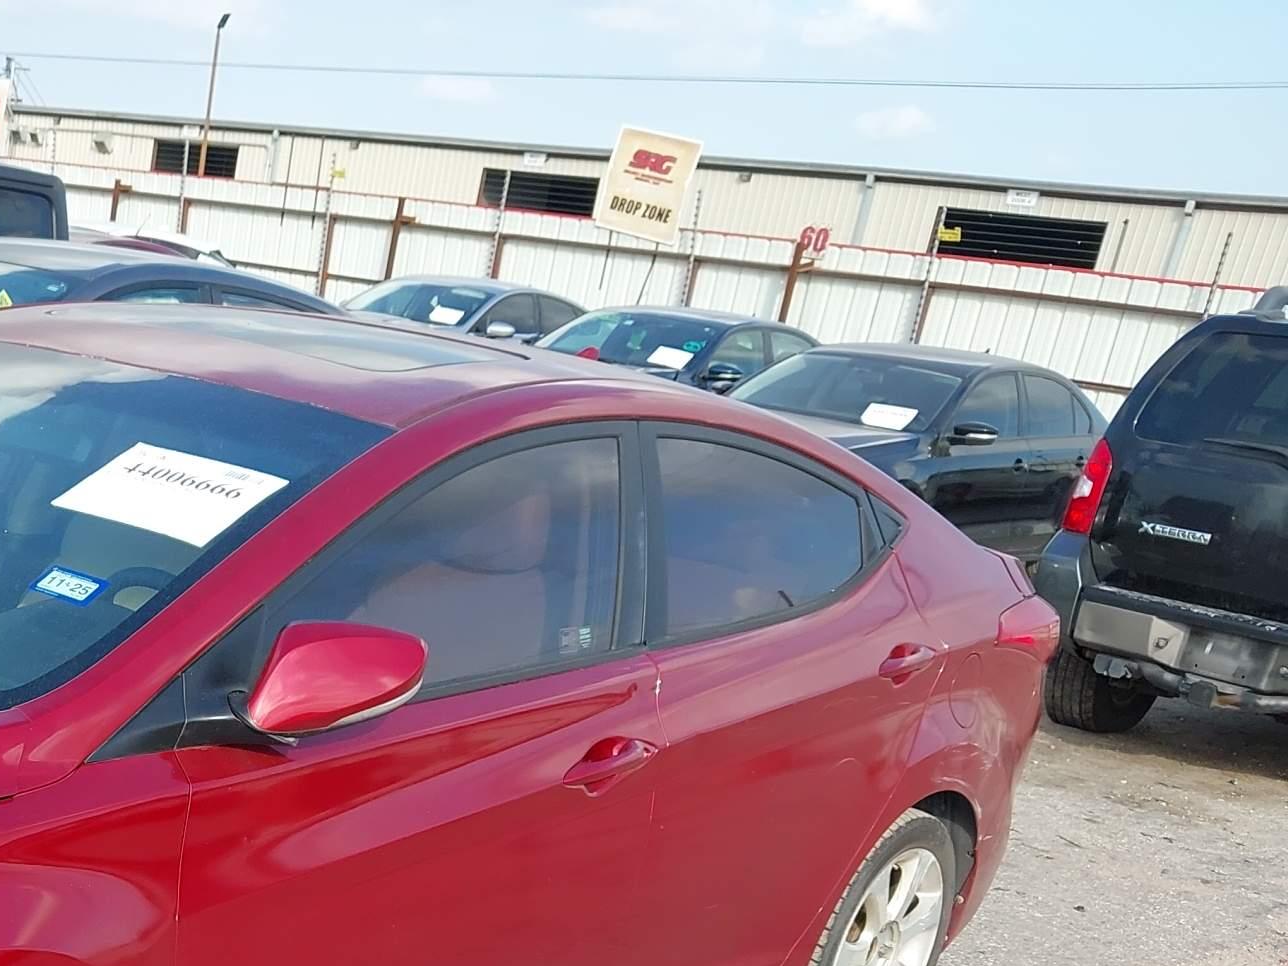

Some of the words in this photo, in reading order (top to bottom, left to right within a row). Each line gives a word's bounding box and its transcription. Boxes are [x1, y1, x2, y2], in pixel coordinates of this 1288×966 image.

[610, 195, 643, 216] DROP
[641, 203, 673, 224] ZONE
[800, 225, 830, 252] 60
[123, 462, 242, 499] 44006666
